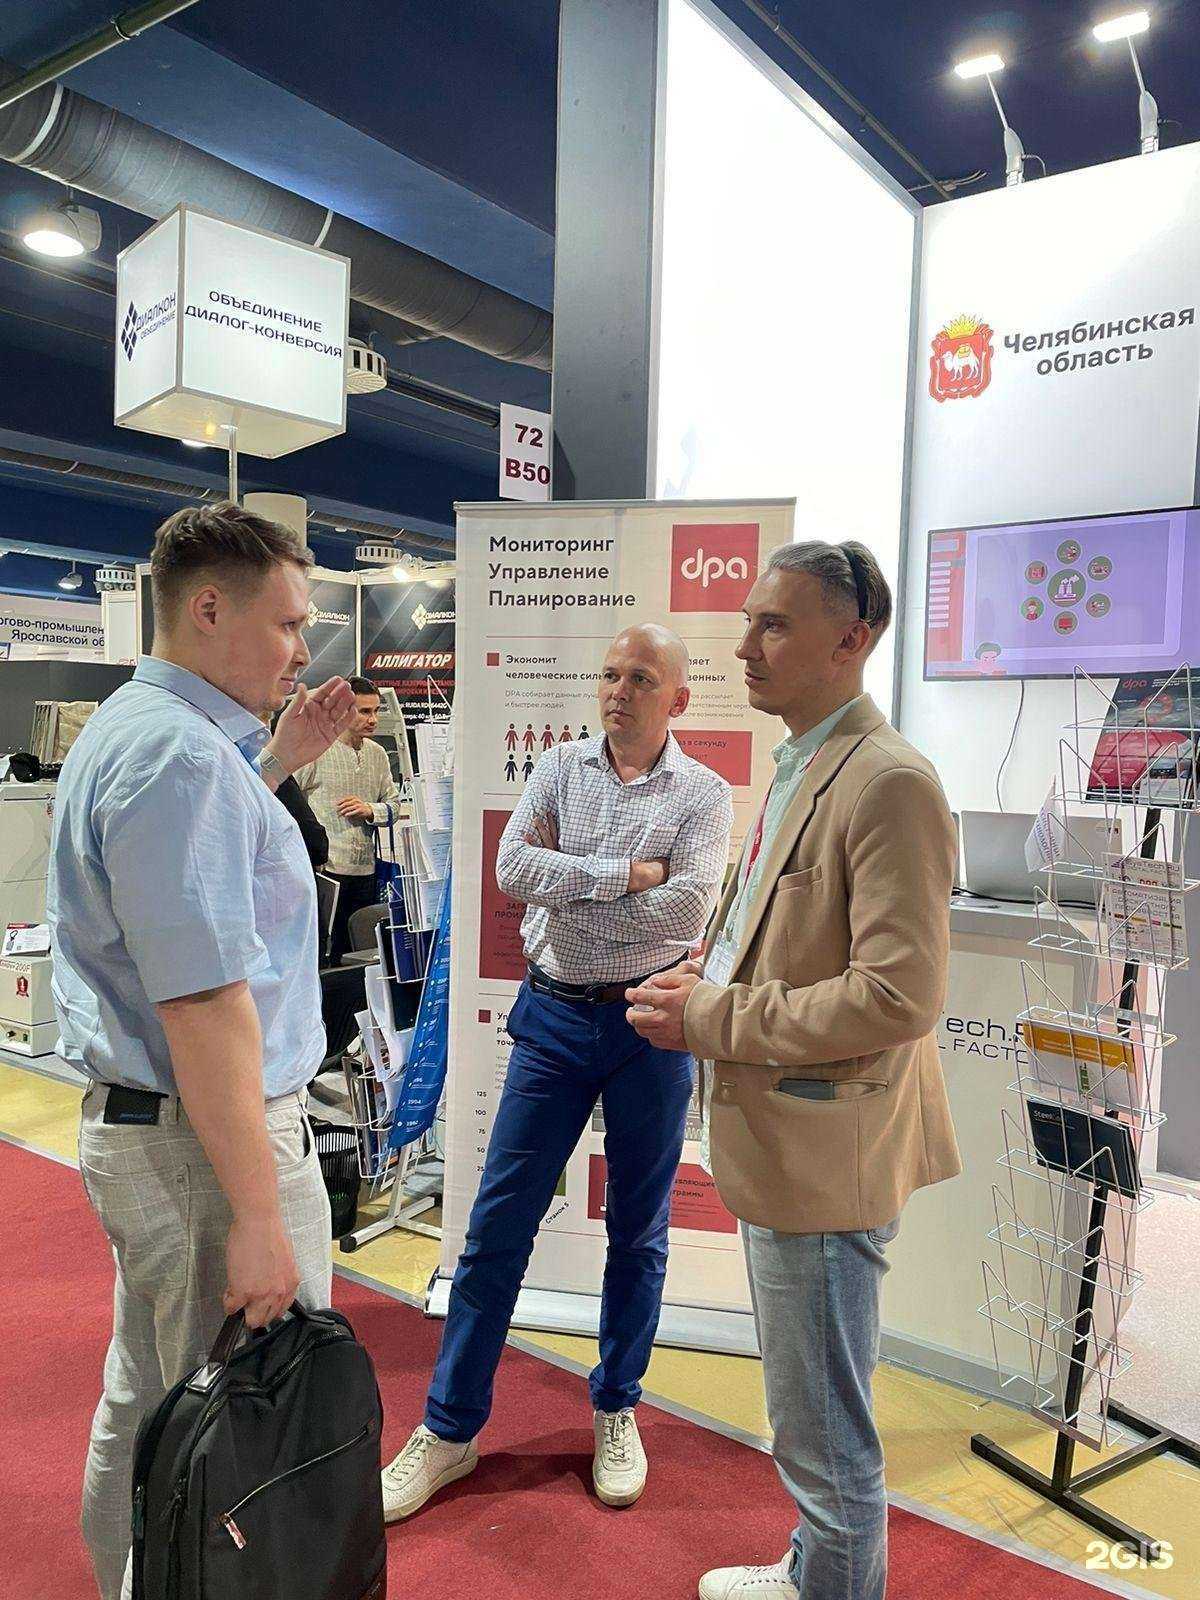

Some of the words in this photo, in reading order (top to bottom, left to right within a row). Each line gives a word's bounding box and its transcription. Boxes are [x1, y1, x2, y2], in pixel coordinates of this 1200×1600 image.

[209, 290, 322, 333] ОБЪЕДИНЕНИЕ
[185, 305, 343, 358] ДИАЛОГ-КОНВЕРСИЯ
[1004, 307, 1195, 354] Челябинская
[1036, 343, 1154, 376] область
[515, 423, 543, 448] 72
[506, 458, 550, 484] B50
[489, 536, 614, 556] Мониторинг
[488, 563, 610, 583] Управление
[681, 548, 748, 588] dpa
[489, 590, 636, 610] Планирование
[12, 630, 88, 646] Ярославской
[371, 654, 453, 668] АЛЛИГАТОР
[506, 654, 557, 664] Экономит
[505, 672, 578, 681] человеческие
[522, 690, 554, 699] собирает
[476, 1090, 487, 1098] 125
